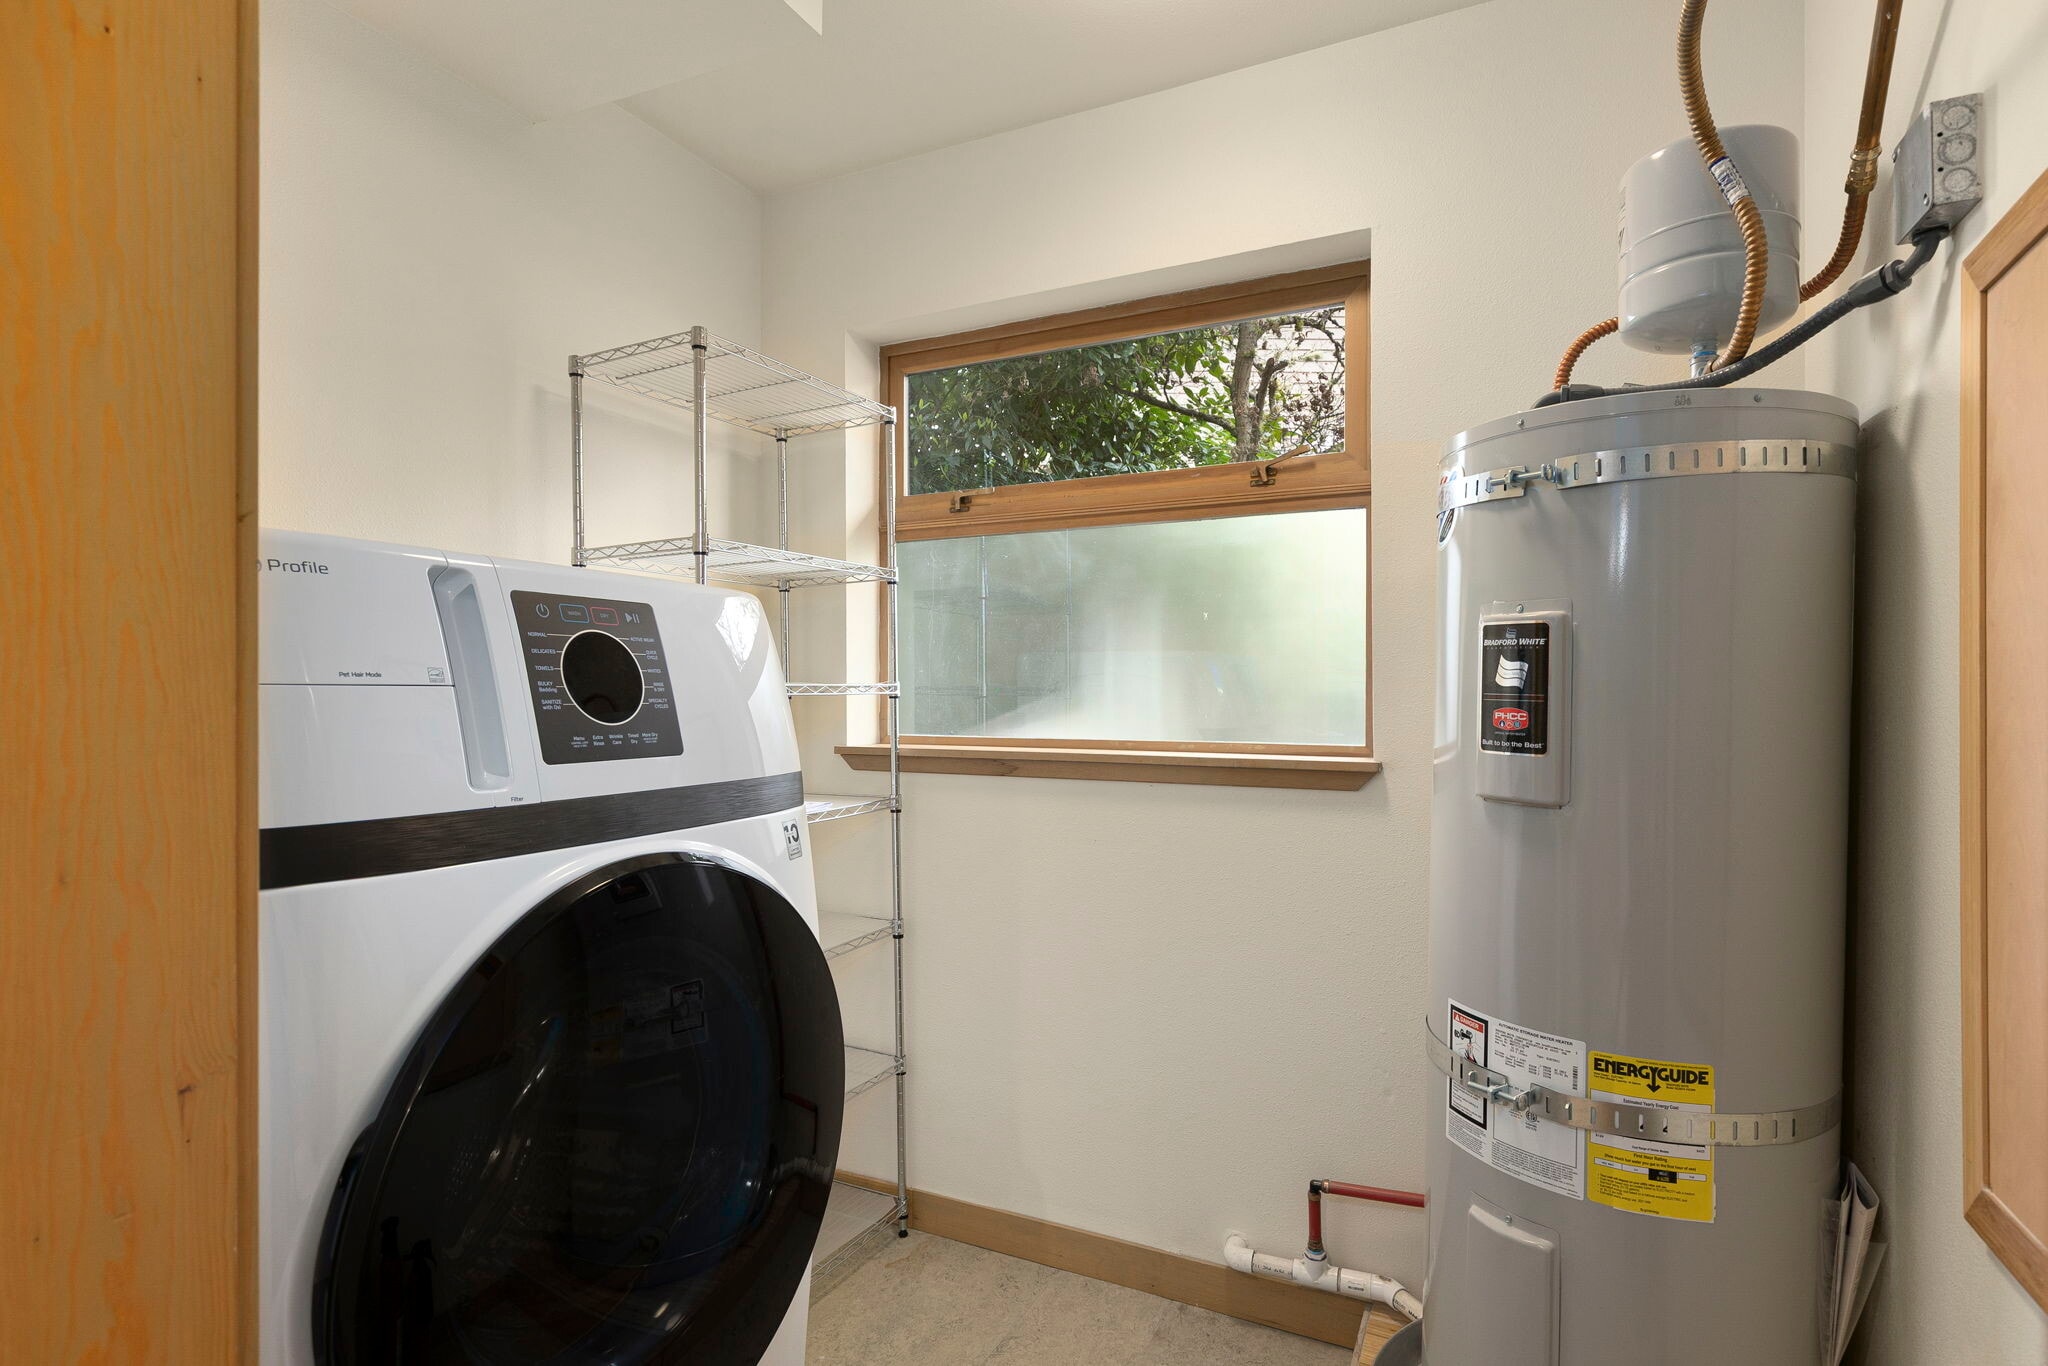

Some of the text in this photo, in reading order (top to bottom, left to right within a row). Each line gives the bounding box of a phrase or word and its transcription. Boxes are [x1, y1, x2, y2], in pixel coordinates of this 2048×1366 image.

[266, 558, 329, 575] Profile
[1483, 637, 1546, 647] BRADFORD WHITE
[1494, 711, 1527, 721] PHCC
[1482, 738, 1494, 746] Built
[1524, 741, 1542, 749] Best
[1498, 1023, 1519, 1033] AUTOMATIC
[1520, 1029, 1539, 1039] STORAGE
[1555, 1038, 1573, 1046] HEATER
[1593, 1057, 1709, 1086] ENERGYGUIDE
[1623, 1098, 1643, 1106] Estimated
